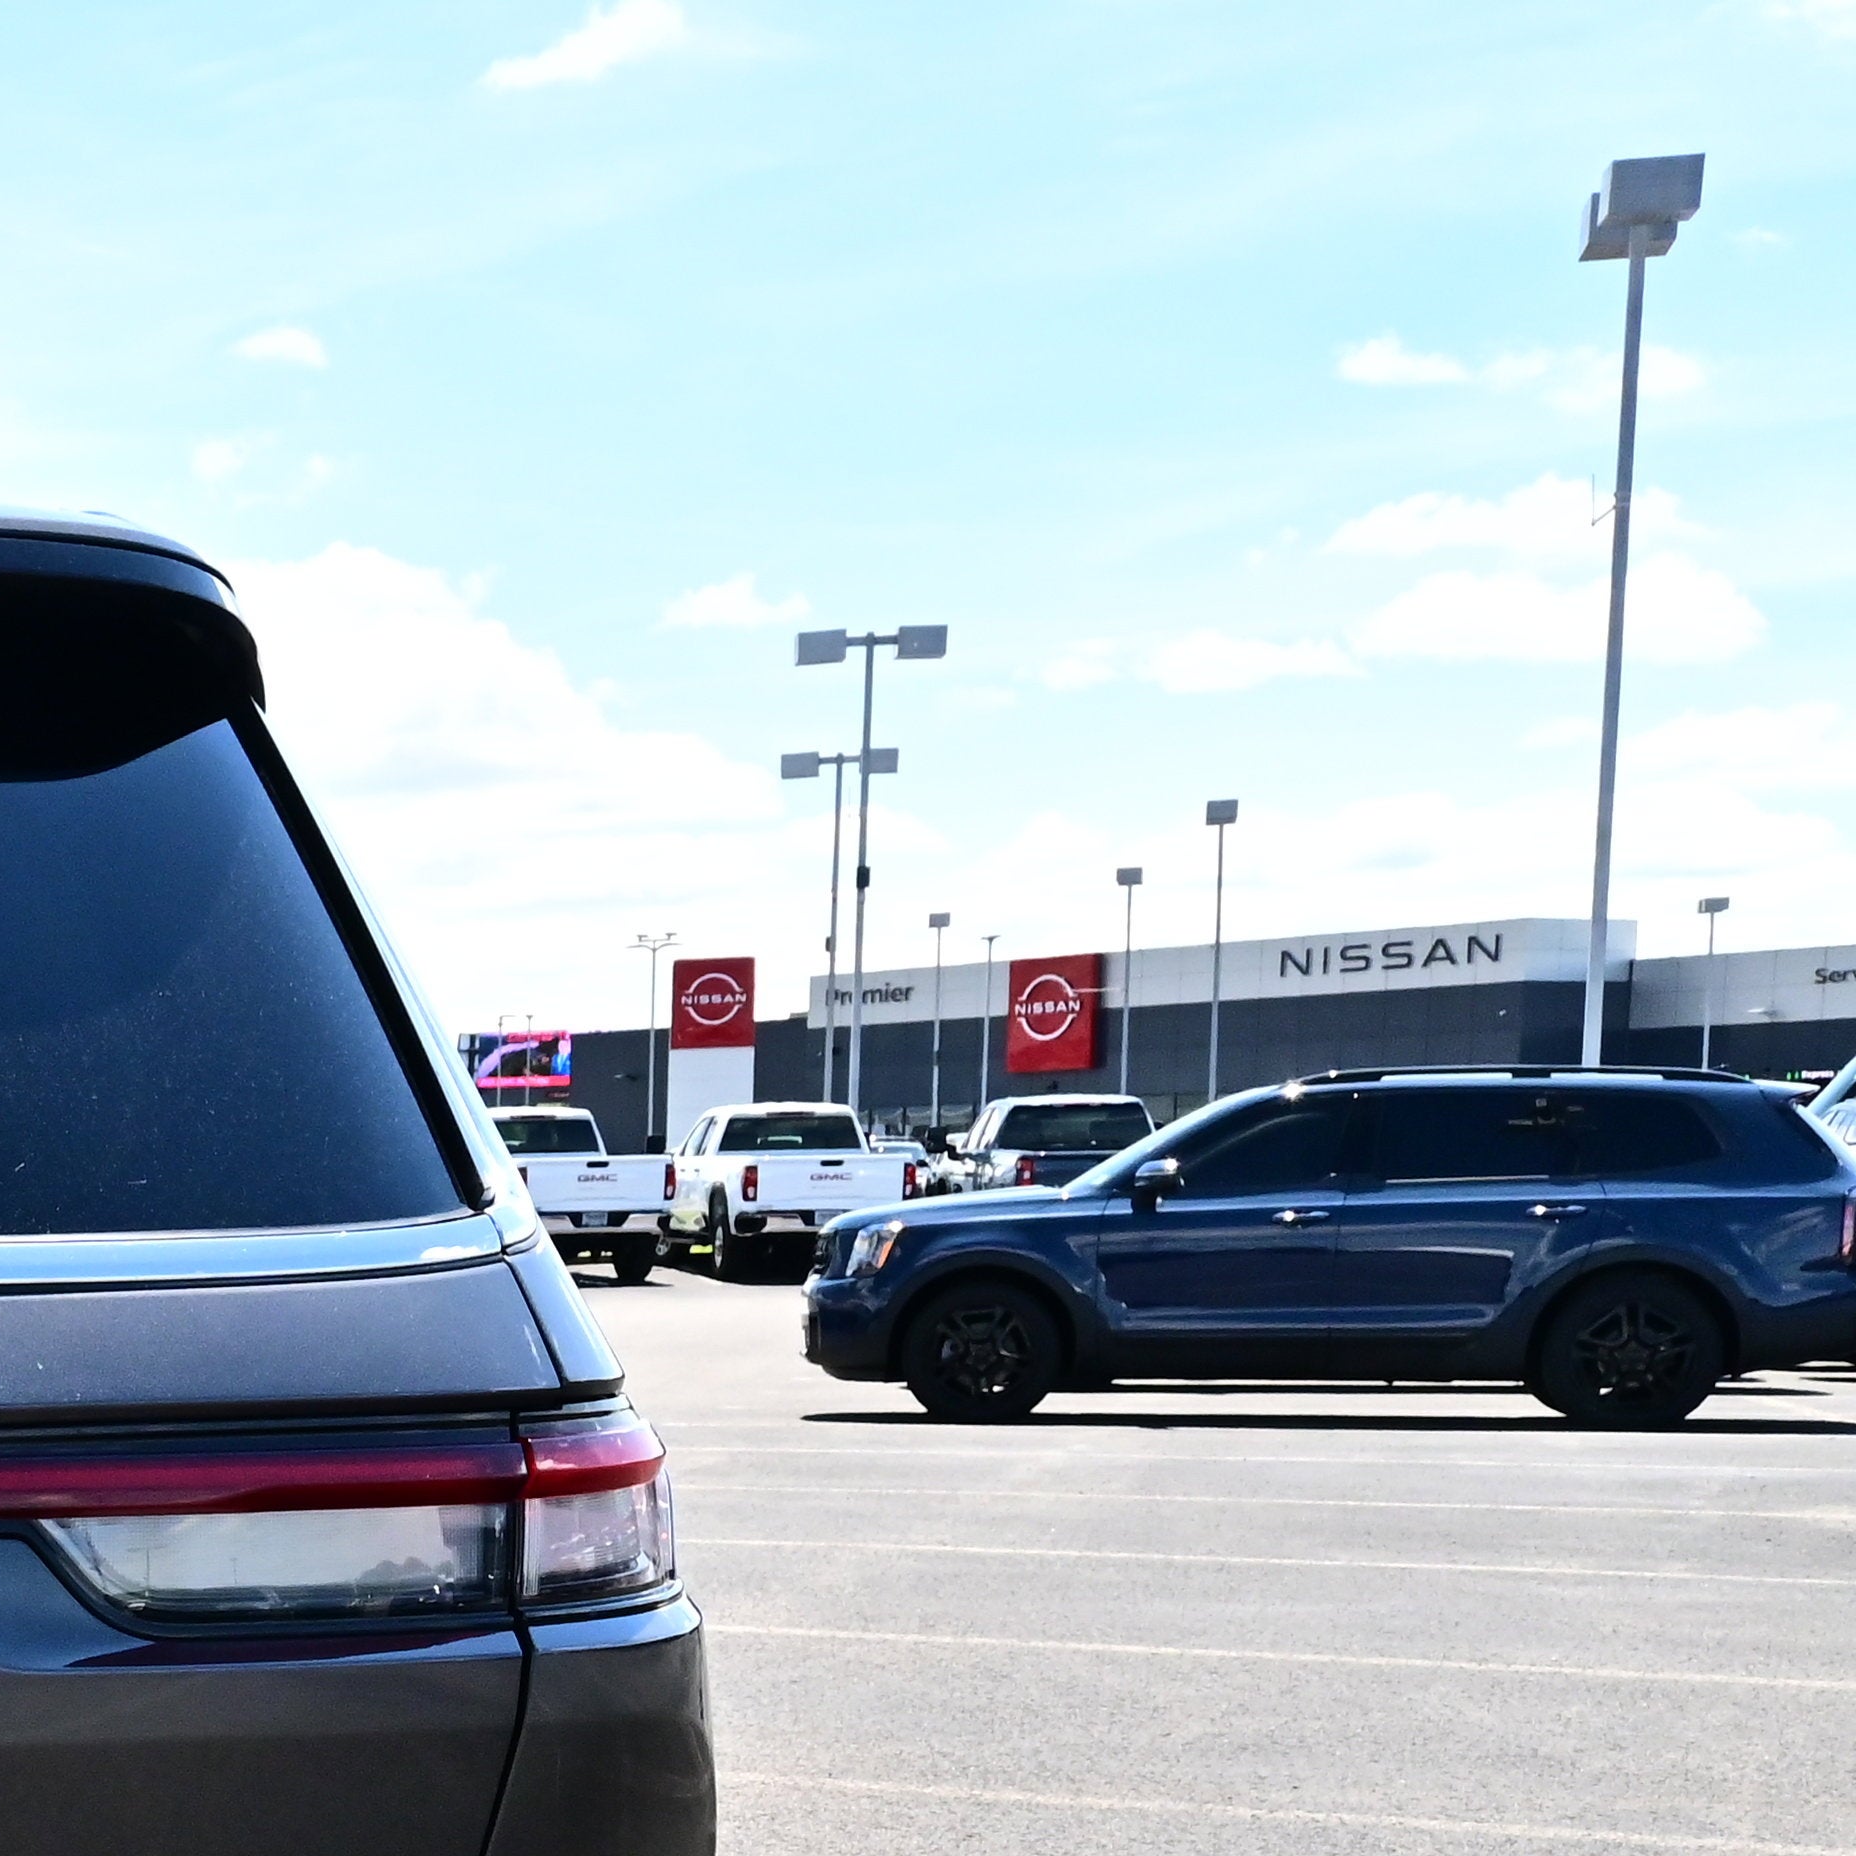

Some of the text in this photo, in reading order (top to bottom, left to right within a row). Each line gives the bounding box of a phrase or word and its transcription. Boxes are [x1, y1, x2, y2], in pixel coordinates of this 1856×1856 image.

[1280, 933, 1503, 977] NISSAN
[681, 993, 747, 1005] NISSAN
[1014, 999, 1081, 1016] NISSAN
[577, 1173, 618, 1182] GMC
[810, 1172, 853, 1181] GMC
